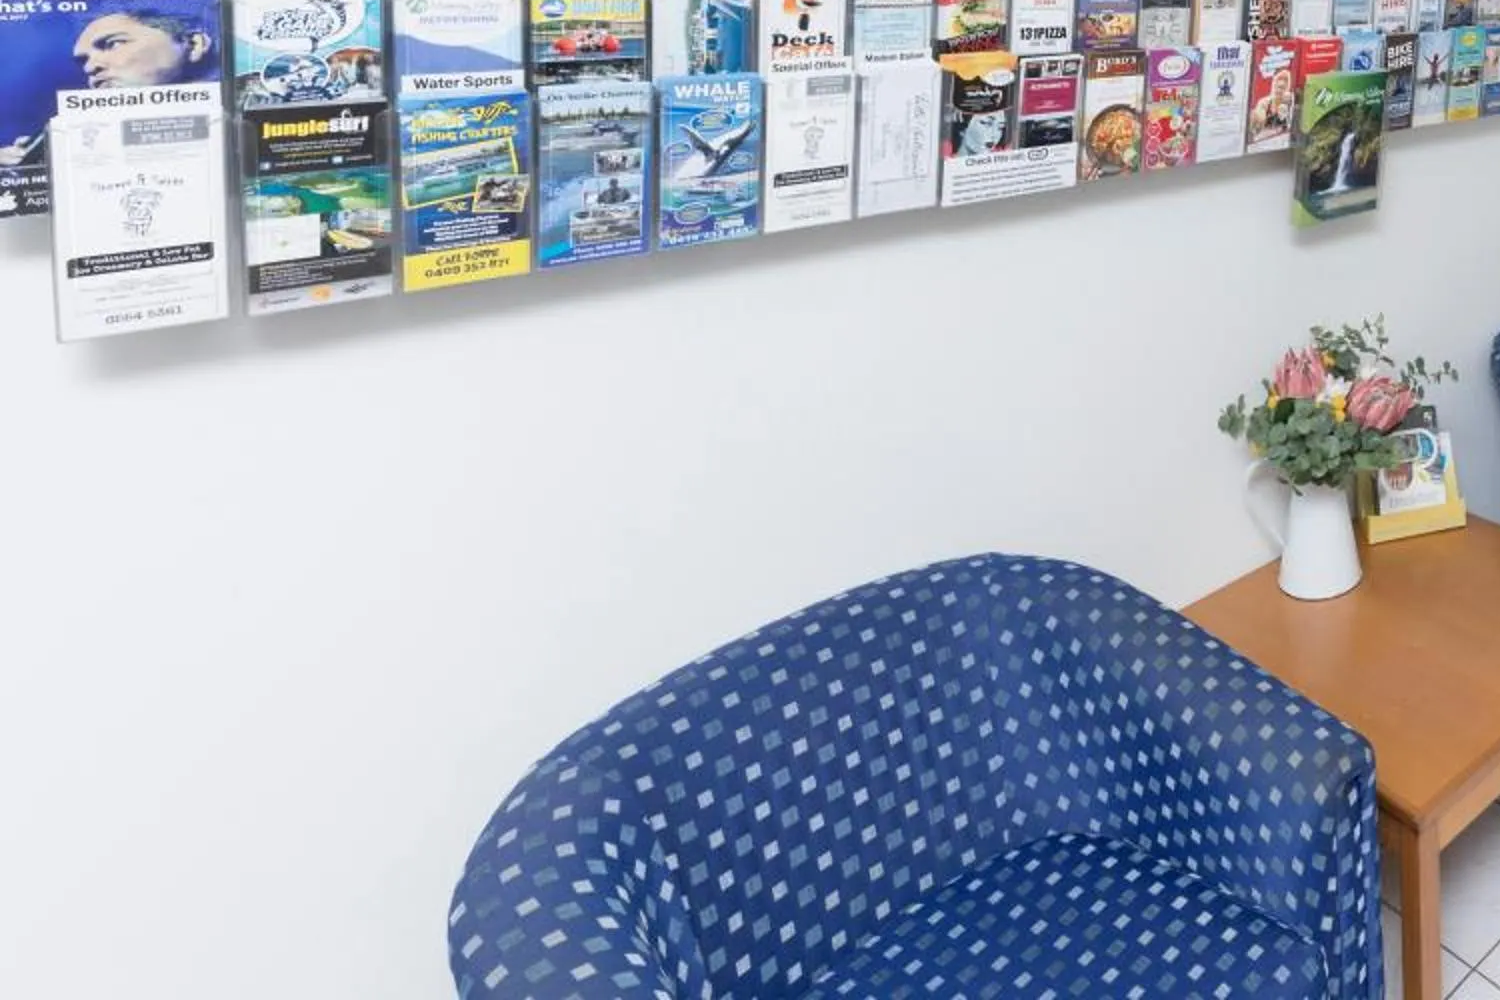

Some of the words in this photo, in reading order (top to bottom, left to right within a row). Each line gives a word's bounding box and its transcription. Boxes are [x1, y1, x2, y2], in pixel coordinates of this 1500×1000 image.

[57, 1, 87, 12] on
[771, 31, 835, 47] Deck
[413, 77, 460, 90] Water
[463, 74, 513, 88] Sports
[673, 80, 751, 99] WHALE
[65, 92, 144, 111] Special
[150, 89, 211, 105] Offers
